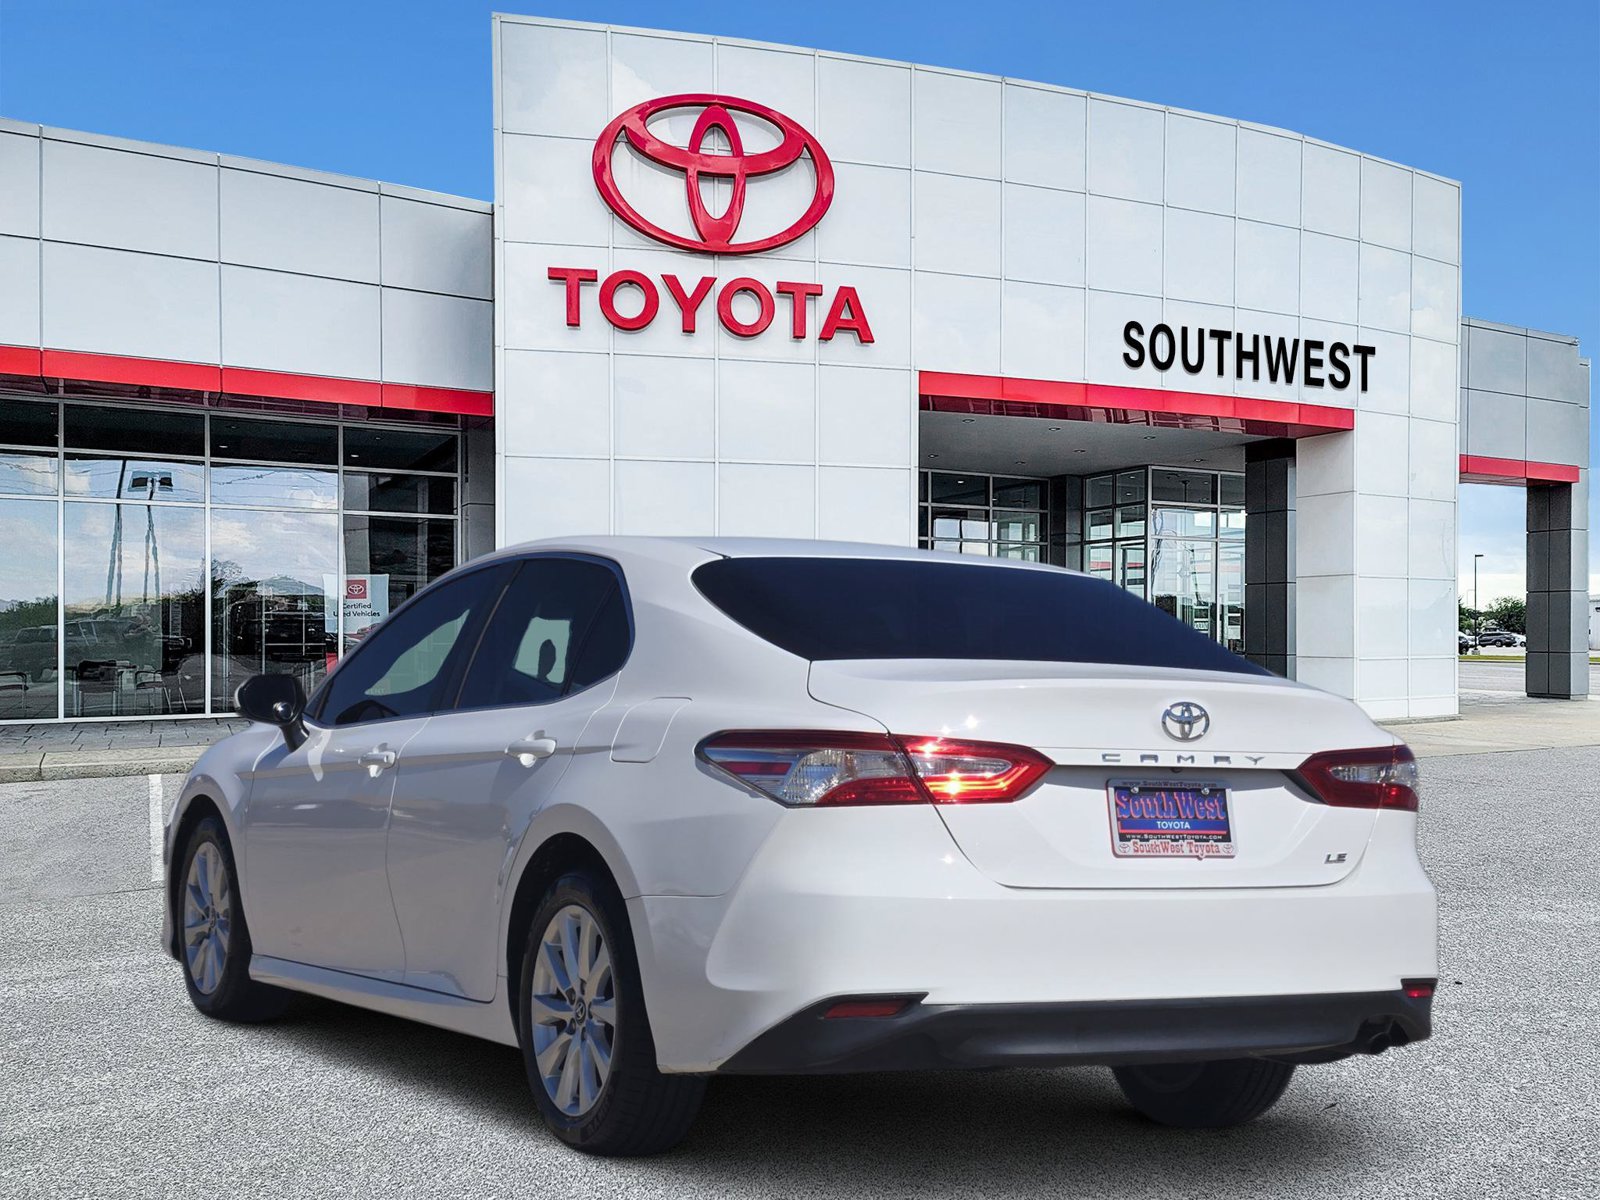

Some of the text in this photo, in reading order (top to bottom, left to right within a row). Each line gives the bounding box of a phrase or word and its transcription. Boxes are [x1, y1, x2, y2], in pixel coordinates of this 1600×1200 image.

[548, 267, 875, 344] TOYOTA
[1123, 320, 1376, 392] SOUTHWEST
[1101, 753, 1266, 765] CAMRY
[1115, 789, 1226, 819] SouthWest
[1157, 821, 1191, 829] TOYOTA
[1132, 841, 1221, 856] SouthWest Toyota
[1324, 853, 1347, 864] LE
